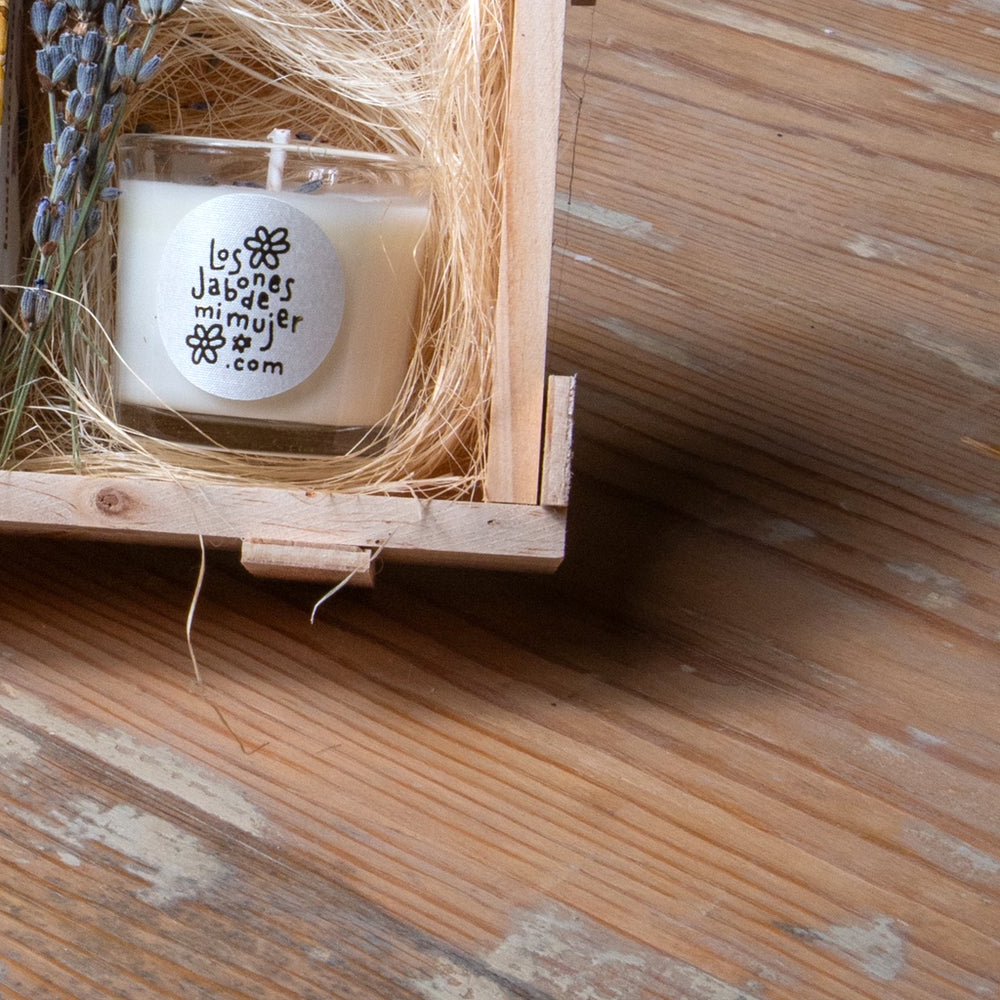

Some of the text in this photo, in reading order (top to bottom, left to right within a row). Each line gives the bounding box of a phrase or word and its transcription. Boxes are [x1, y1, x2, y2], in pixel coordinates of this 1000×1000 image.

[210, 238, 242, 275] Los
[191, 266, 295, 301] Jabones
[241, 290, 269, 310] de
[194, 302, 303, 352] mi mujer
[226, 358, 284, 375] .com
